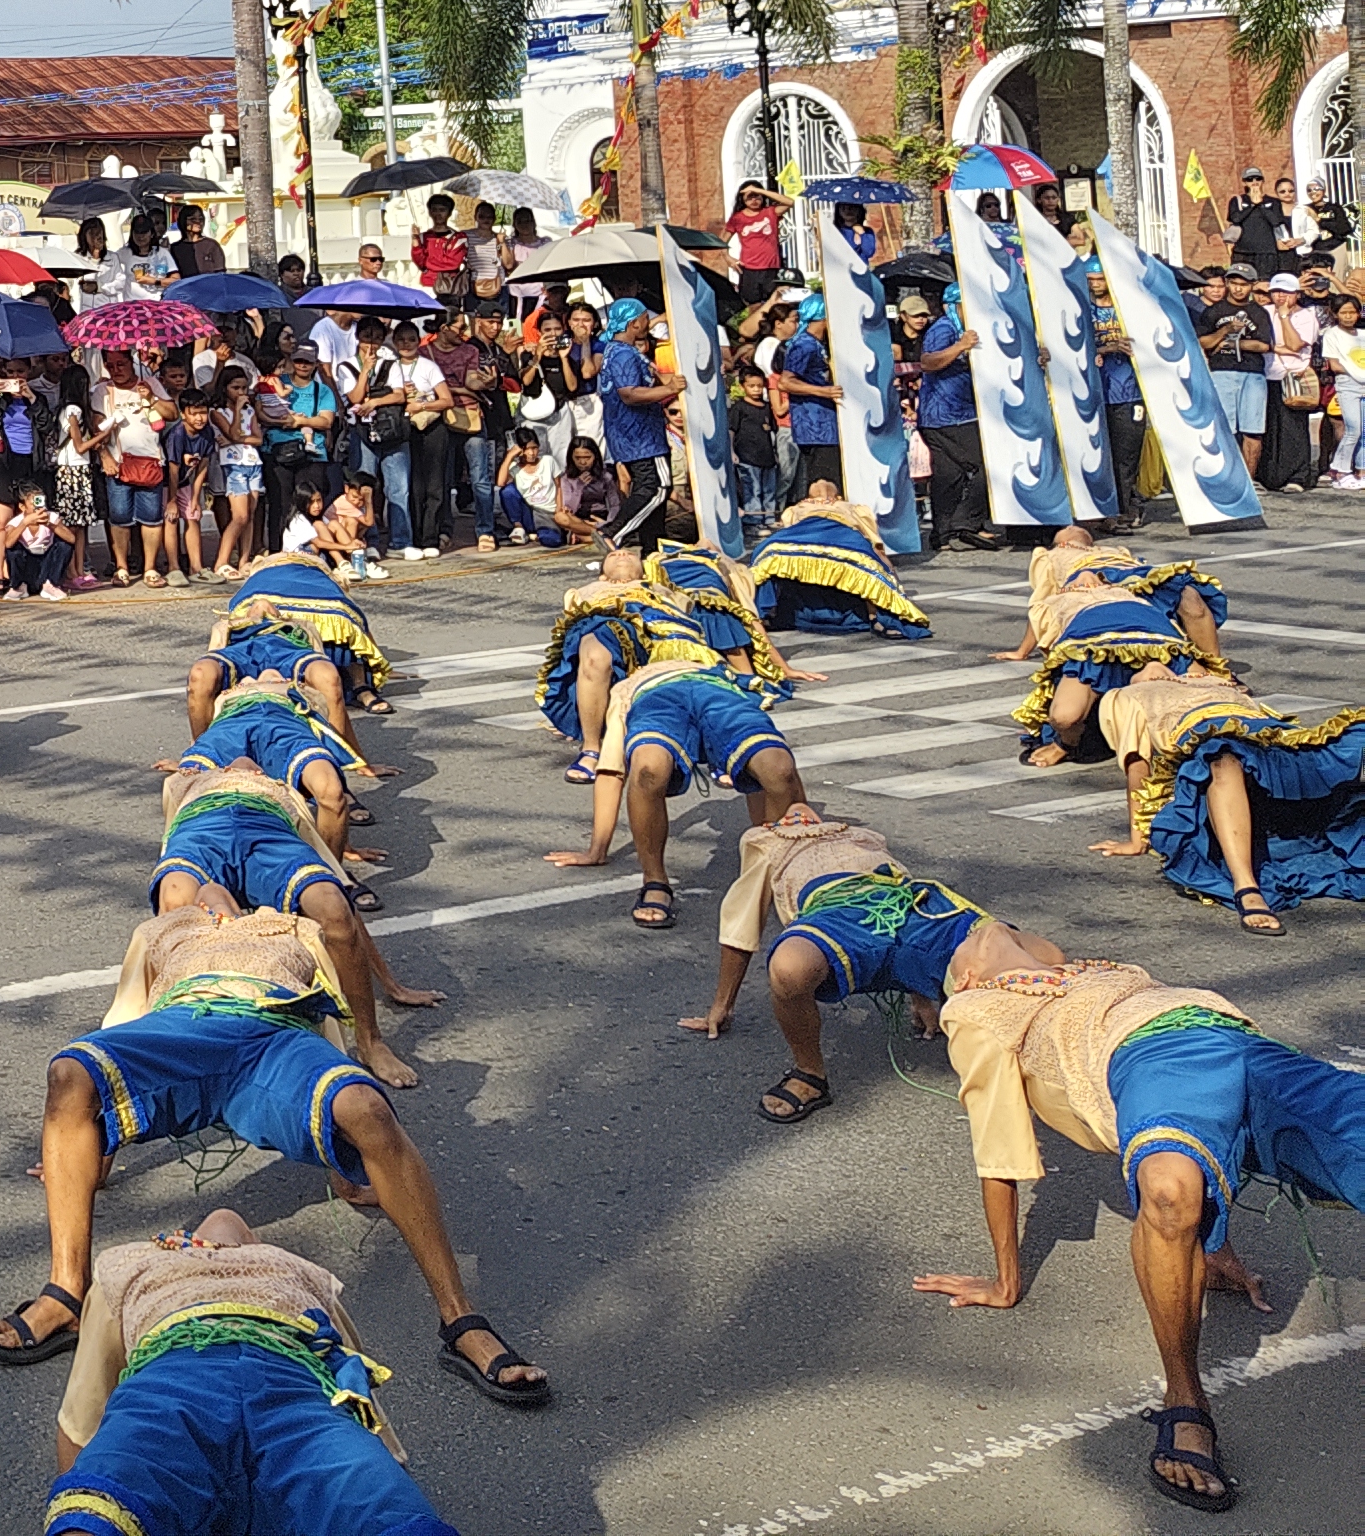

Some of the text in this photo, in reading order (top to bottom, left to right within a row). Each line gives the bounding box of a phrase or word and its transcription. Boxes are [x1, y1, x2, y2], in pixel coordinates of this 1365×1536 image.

[549, 20, 579, 38] PETER
[367, 118, 386, 132] Lady
[7, 194, 46, 209] CENTRA
